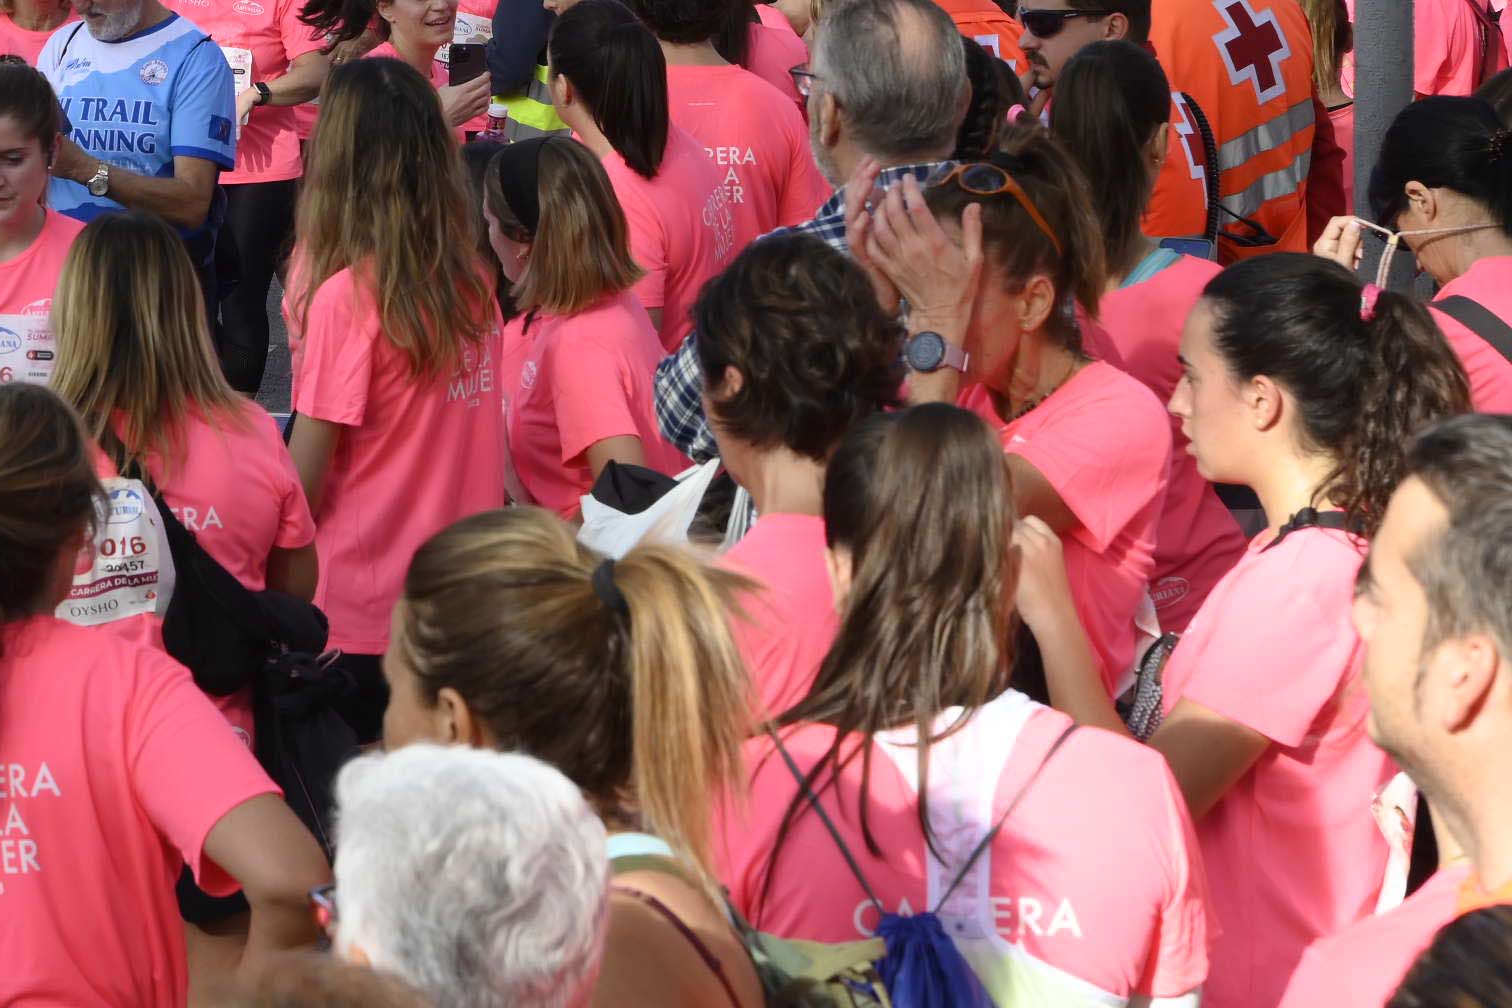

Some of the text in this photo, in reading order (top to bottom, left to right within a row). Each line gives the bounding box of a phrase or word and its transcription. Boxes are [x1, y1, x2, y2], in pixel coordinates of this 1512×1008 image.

[80, 97, 158, 126] TRAIL
[100, 536, 147, 557] 016
[70, 580, 113, 596] CARRERA
[114, 578, 127, 586] DE
[128, 578, 139, 586] LA
[70, 599, 119, 617] OYSHO
